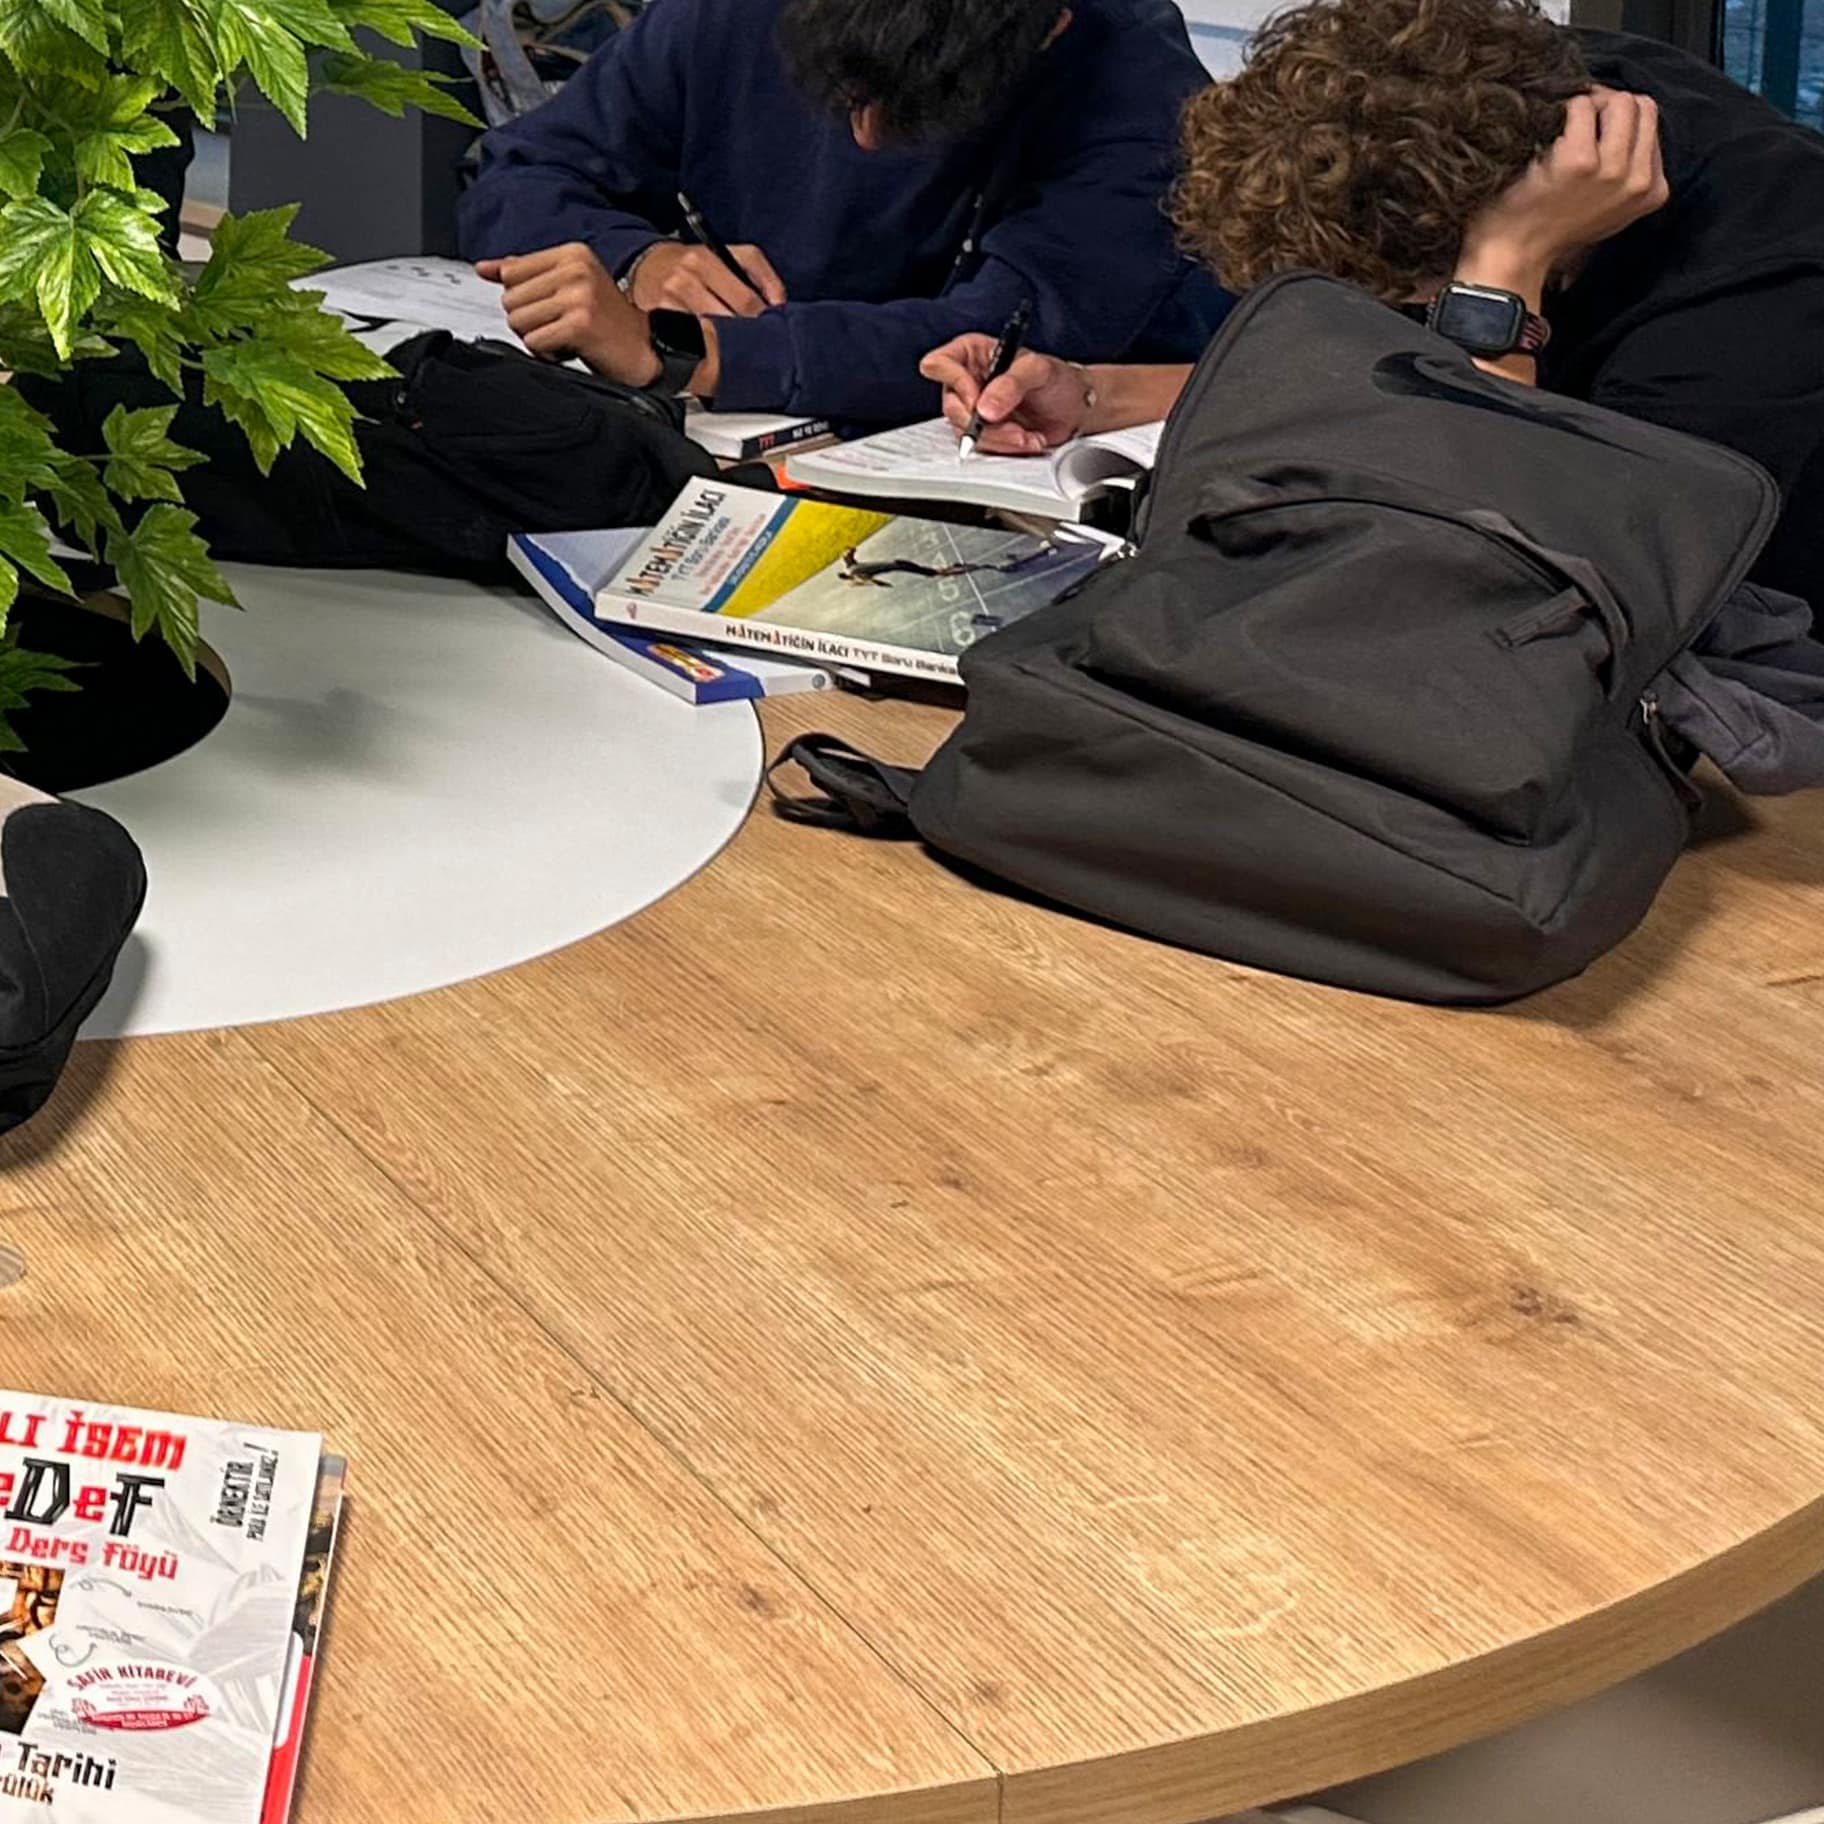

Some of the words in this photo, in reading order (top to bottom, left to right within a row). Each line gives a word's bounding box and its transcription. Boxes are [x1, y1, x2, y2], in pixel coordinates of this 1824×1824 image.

[726, 624, 815, 651] MATEMATİĞİN
[818, 639, 849, 658] İLACI
[852, 647, 879, 663] TYT
[58, 1410, 187, 1471] İSEM
[5, 1527, 89, 1565] Ders
[66, 1666, 114, 1691] SAFİR
[117, 1664, 198, 1689] KİTABEVİ
[16, 1741, 117, 1790] Tarihi
